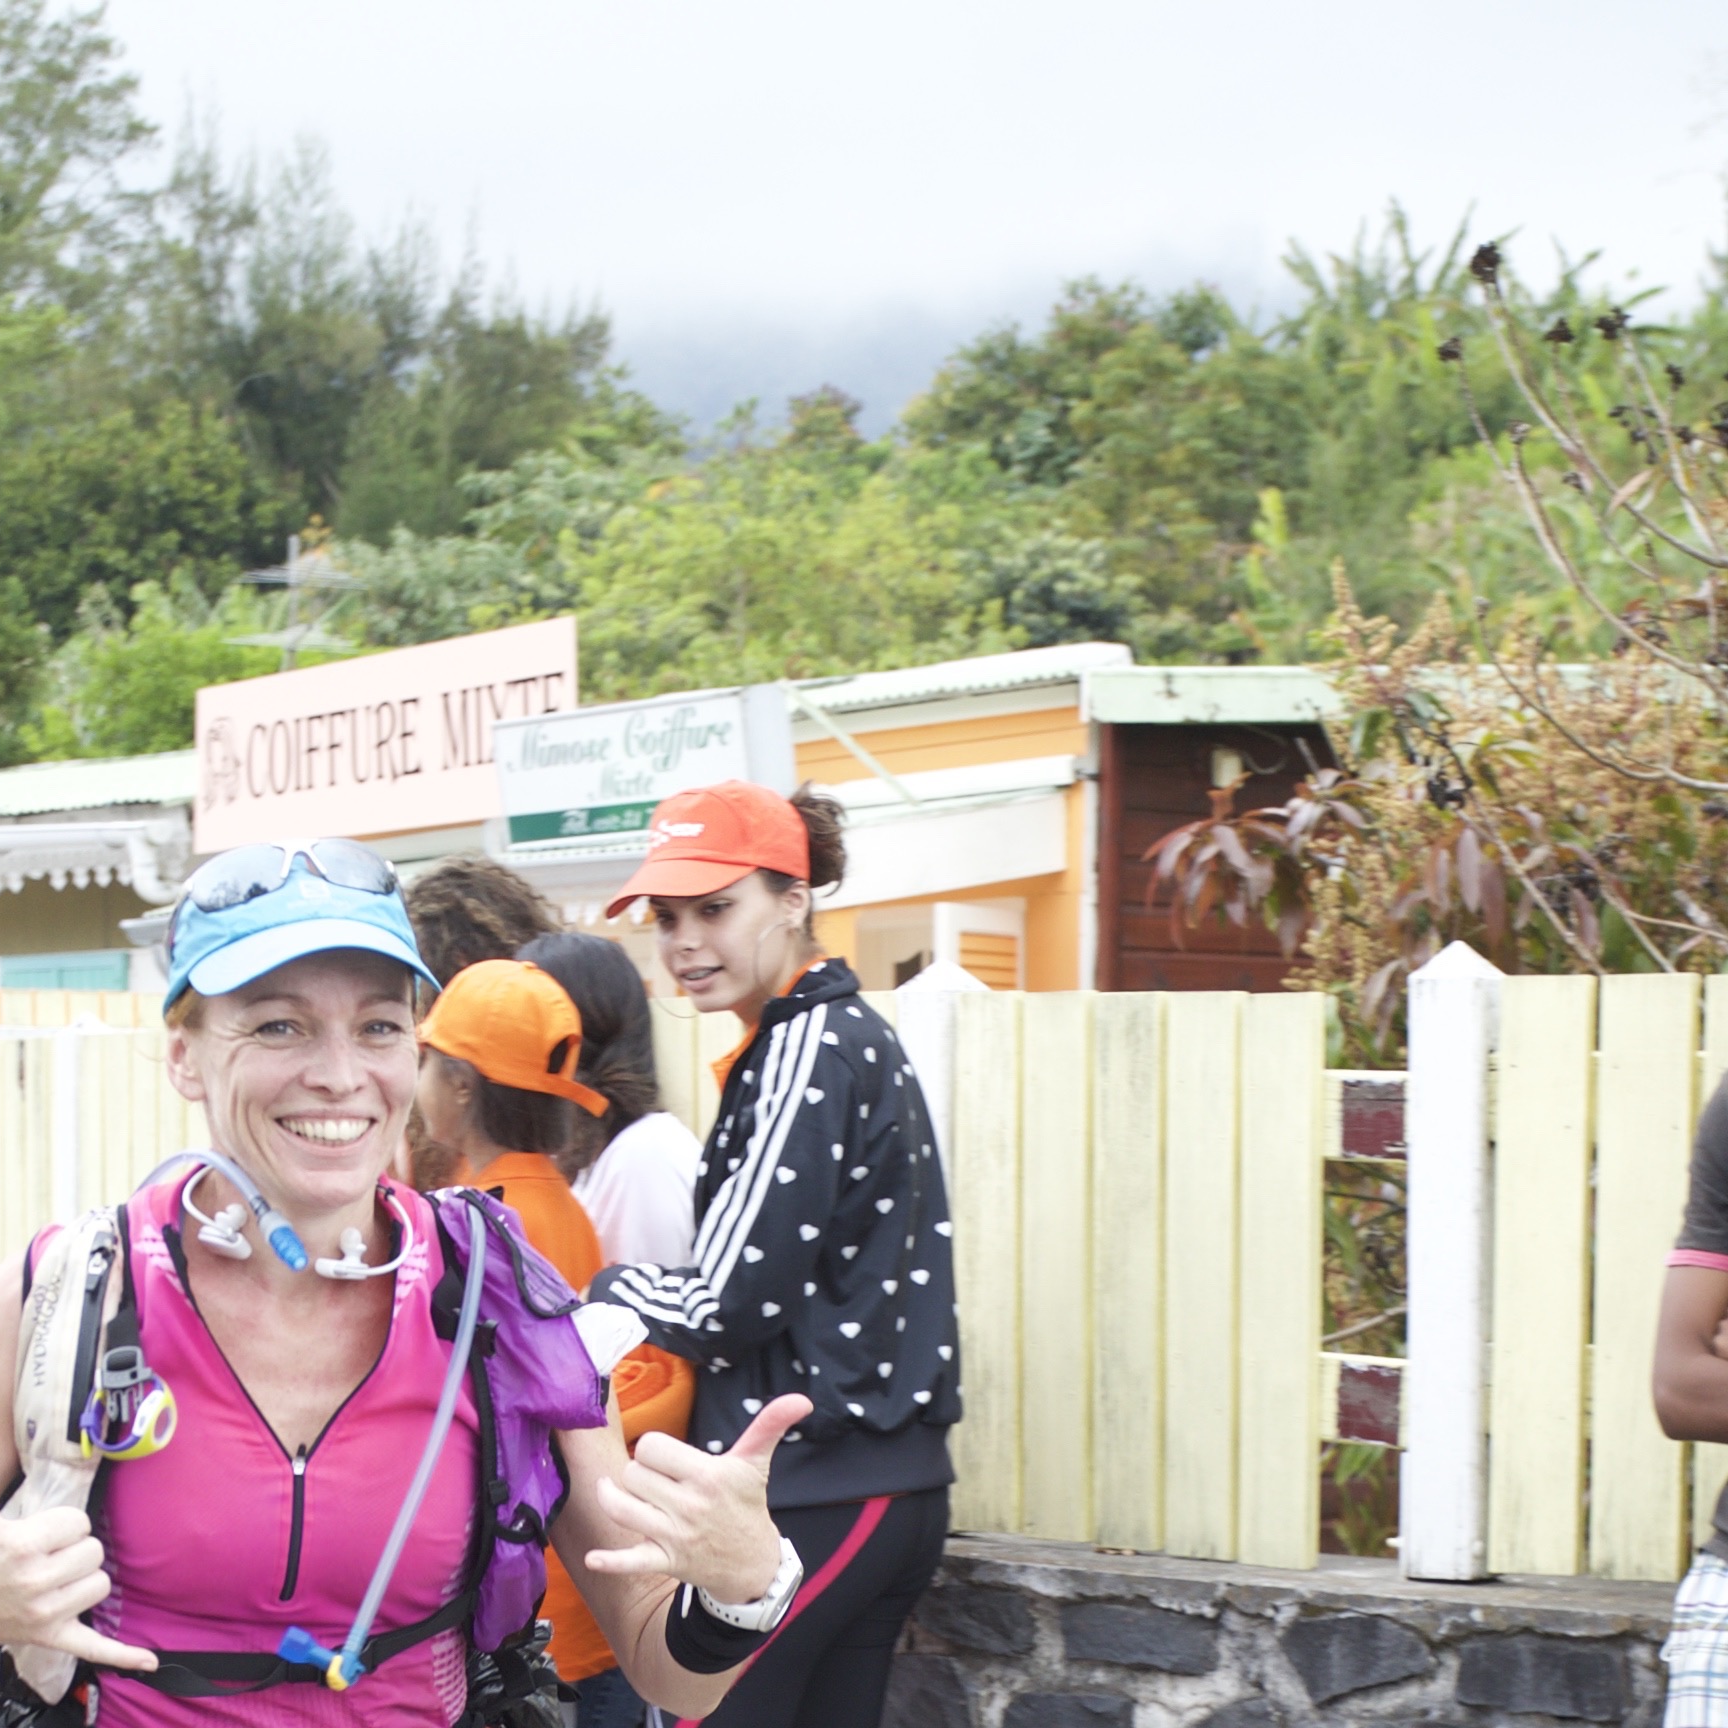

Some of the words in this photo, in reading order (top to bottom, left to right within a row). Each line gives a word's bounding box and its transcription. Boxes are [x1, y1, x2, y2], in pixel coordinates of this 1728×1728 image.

[246, 698, 423, 798] COIFFURE
[507, 724, 612, 773] Mimose
[624, 706, 733, 773] Coiffure
